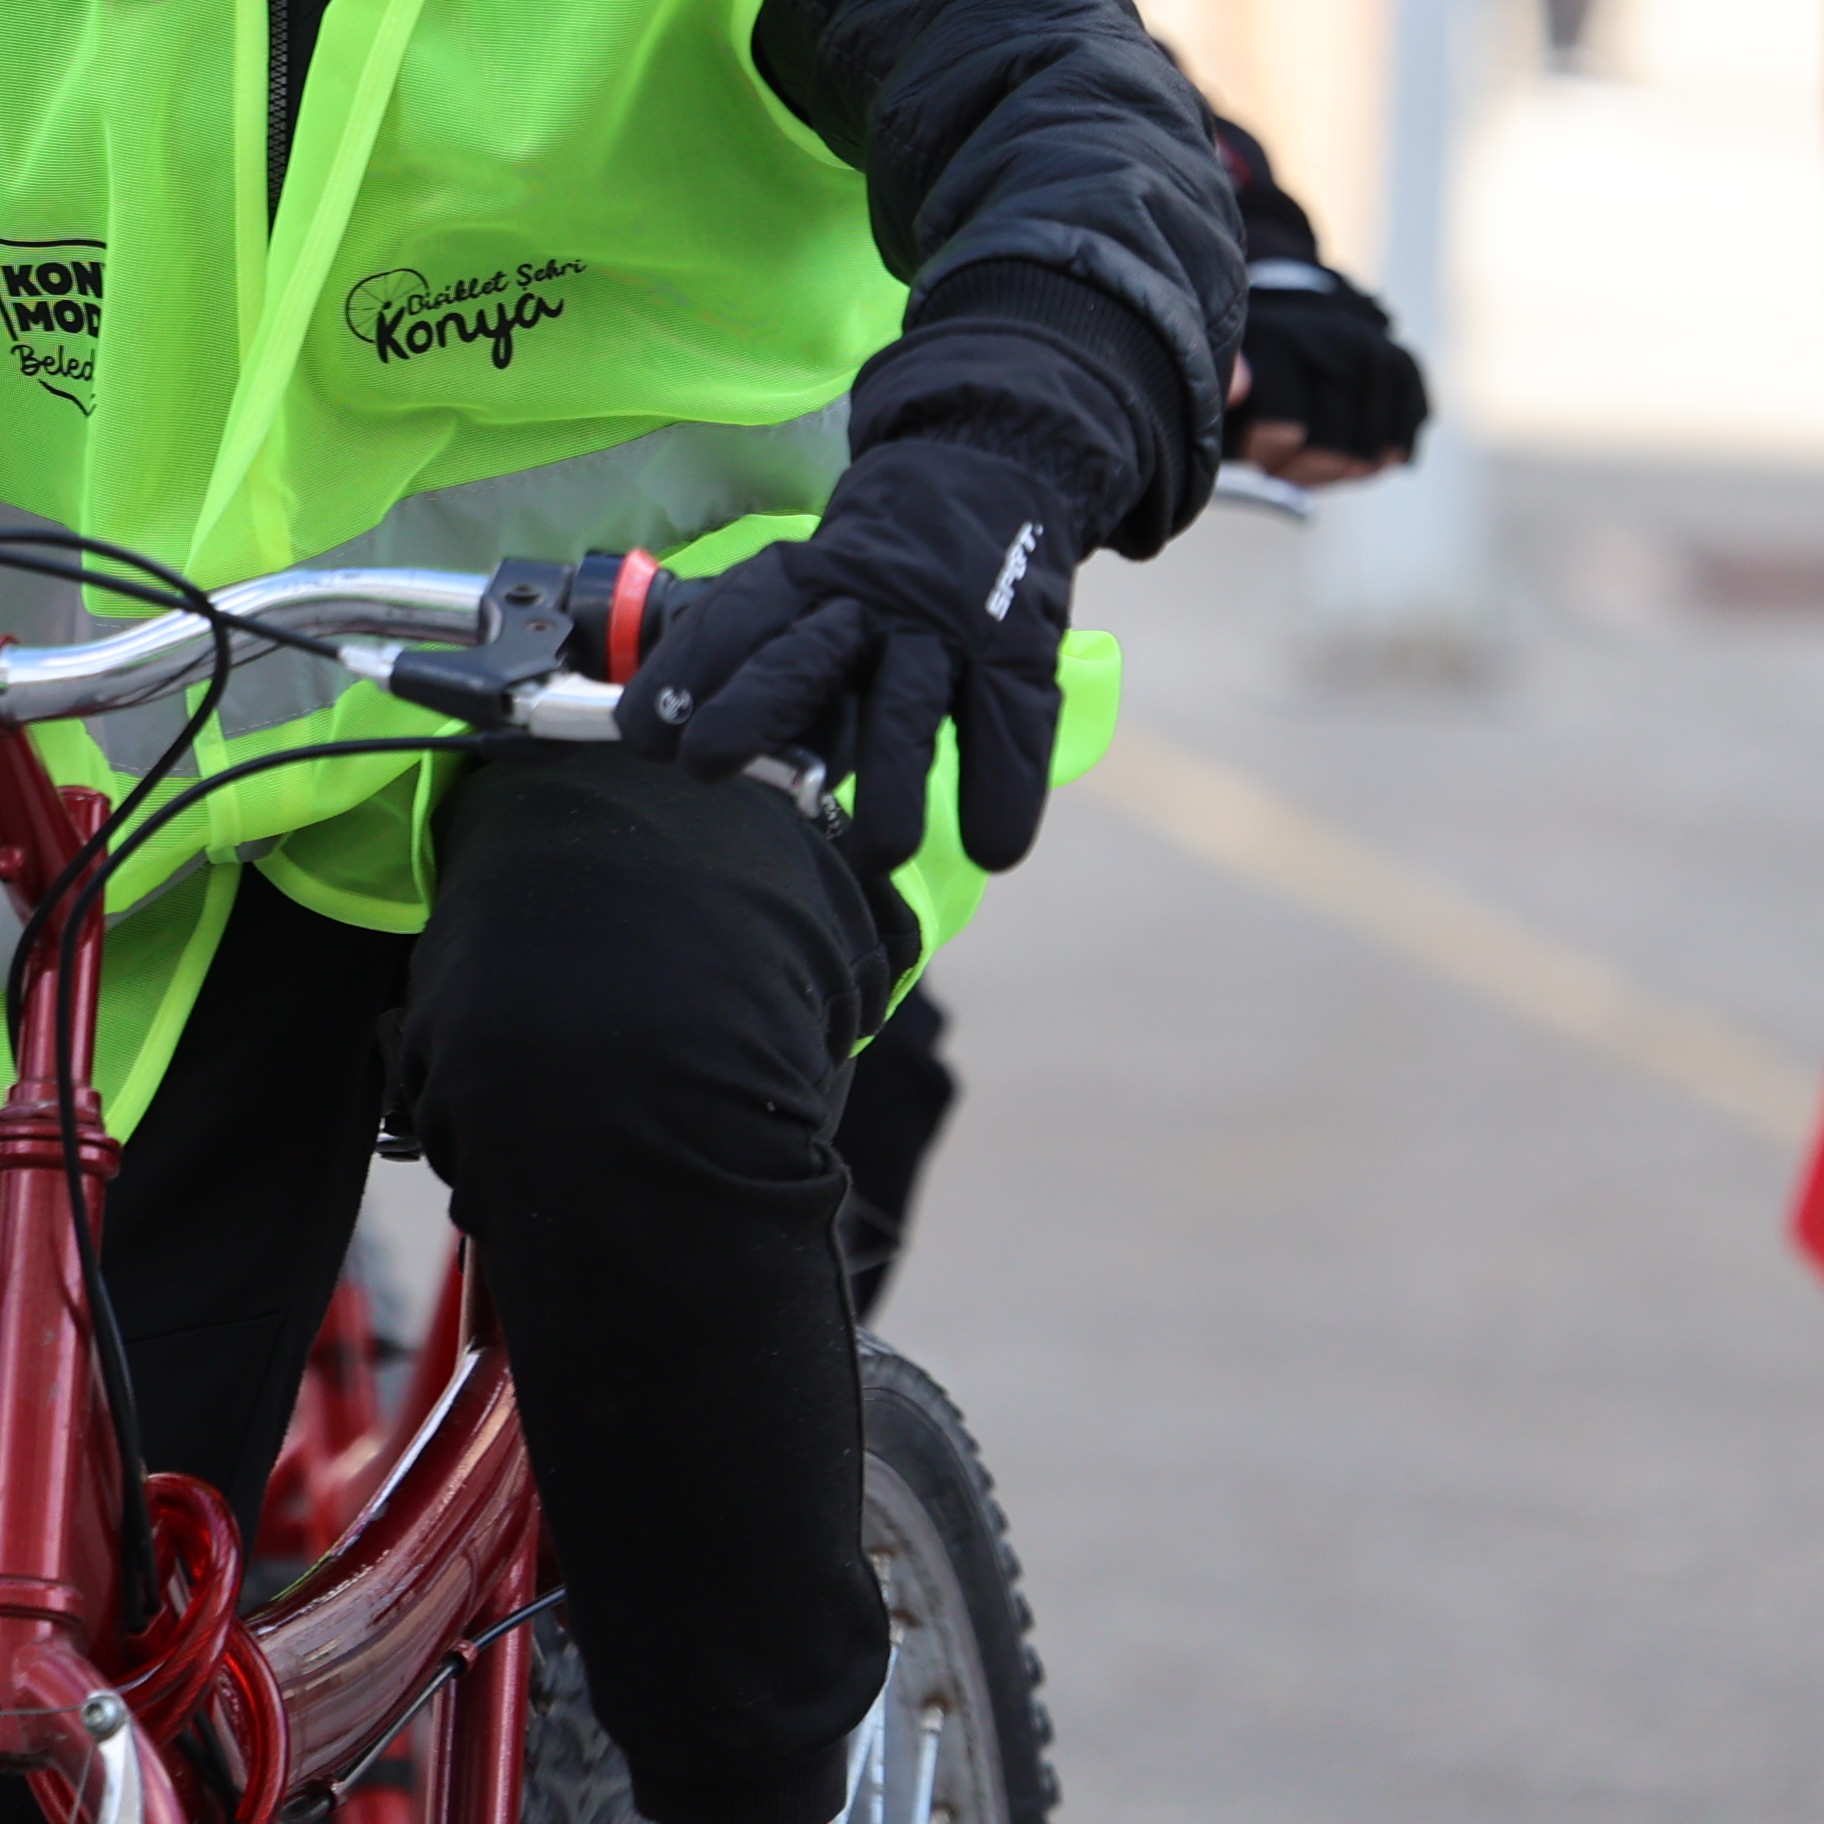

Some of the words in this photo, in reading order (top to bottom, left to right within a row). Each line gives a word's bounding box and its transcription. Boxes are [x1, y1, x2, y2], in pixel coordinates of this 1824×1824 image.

[406, 271, 510, 315] Bisiklet
[515, 258, 588, 291] Şehri
[377, 293, 564, 369] Konya
